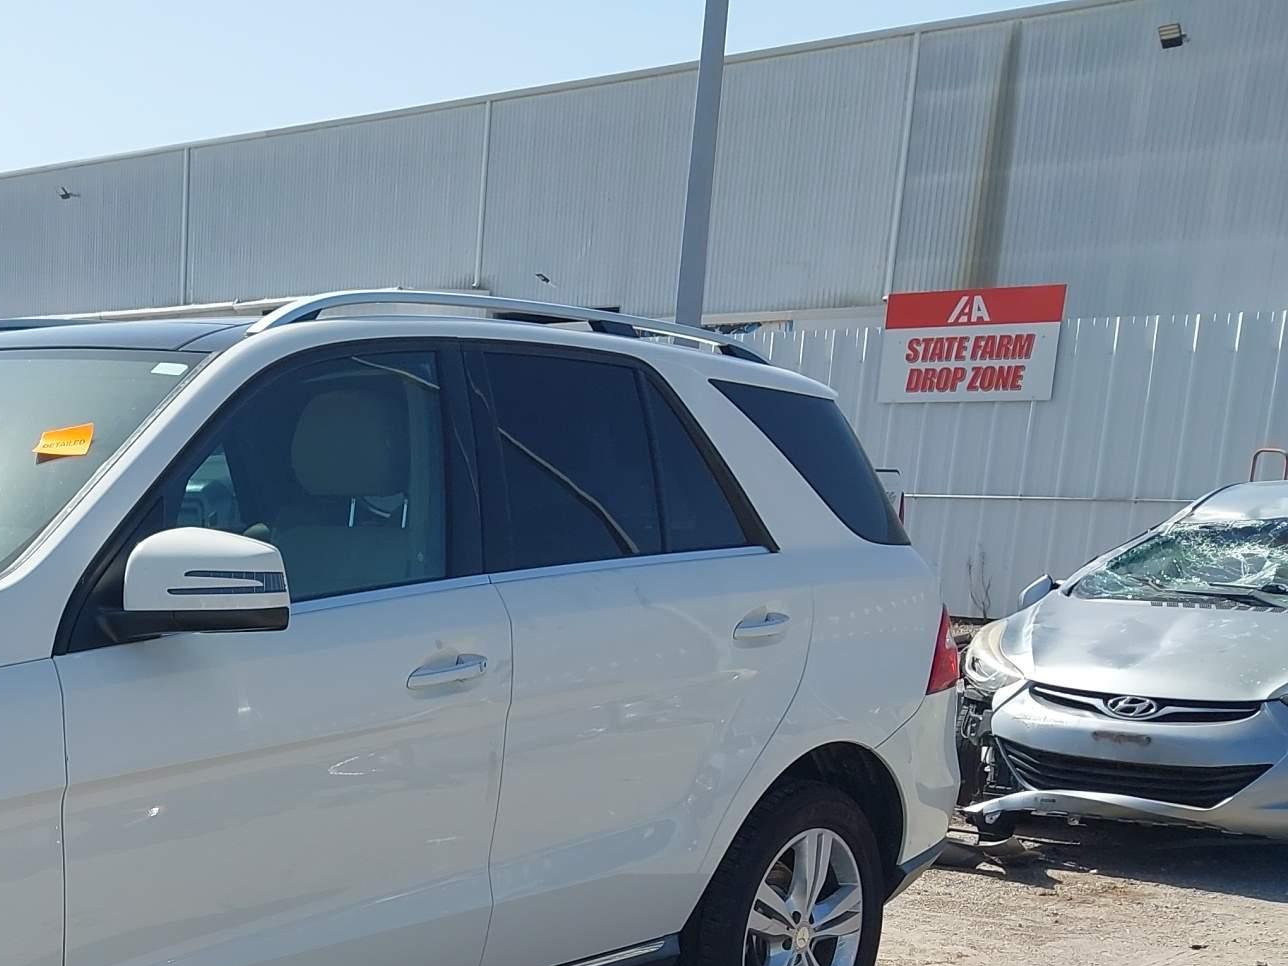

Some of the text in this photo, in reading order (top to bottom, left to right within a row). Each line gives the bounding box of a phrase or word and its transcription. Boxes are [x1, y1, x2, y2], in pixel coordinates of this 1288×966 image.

[905, 333, 1036, 363] STATE FARM
[905, 364, 1026, 393] DROP ZONE
[42, 438, 86, 448] DETAILED
